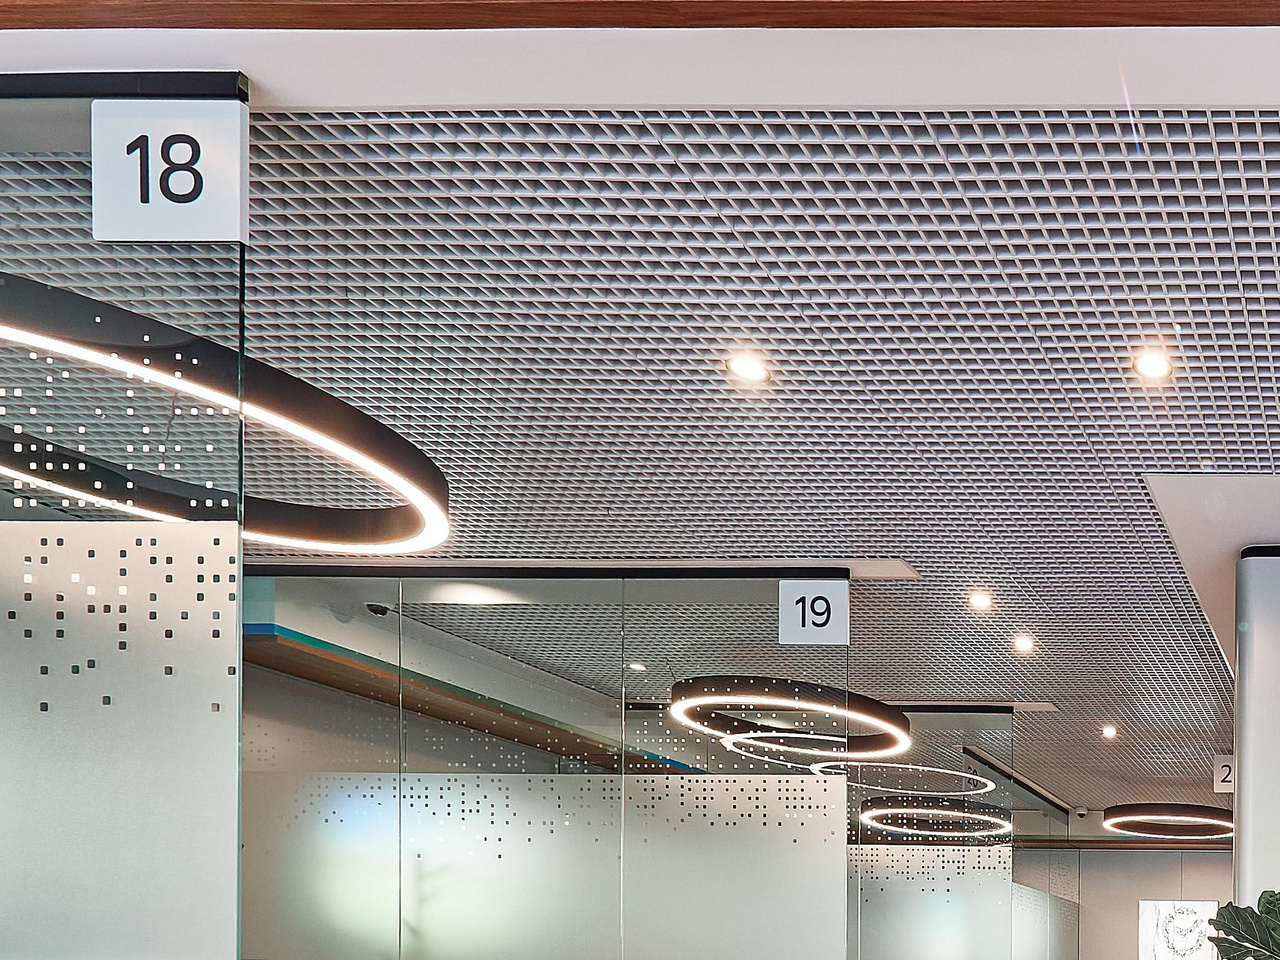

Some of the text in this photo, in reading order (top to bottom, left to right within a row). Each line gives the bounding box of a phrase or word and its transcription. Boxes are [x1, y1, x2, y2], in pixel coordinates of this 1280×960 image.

[125, 133, 205, 205] 18
[794, 595, 833, 629] 19
[1220, 764, 1233, 784] 2
